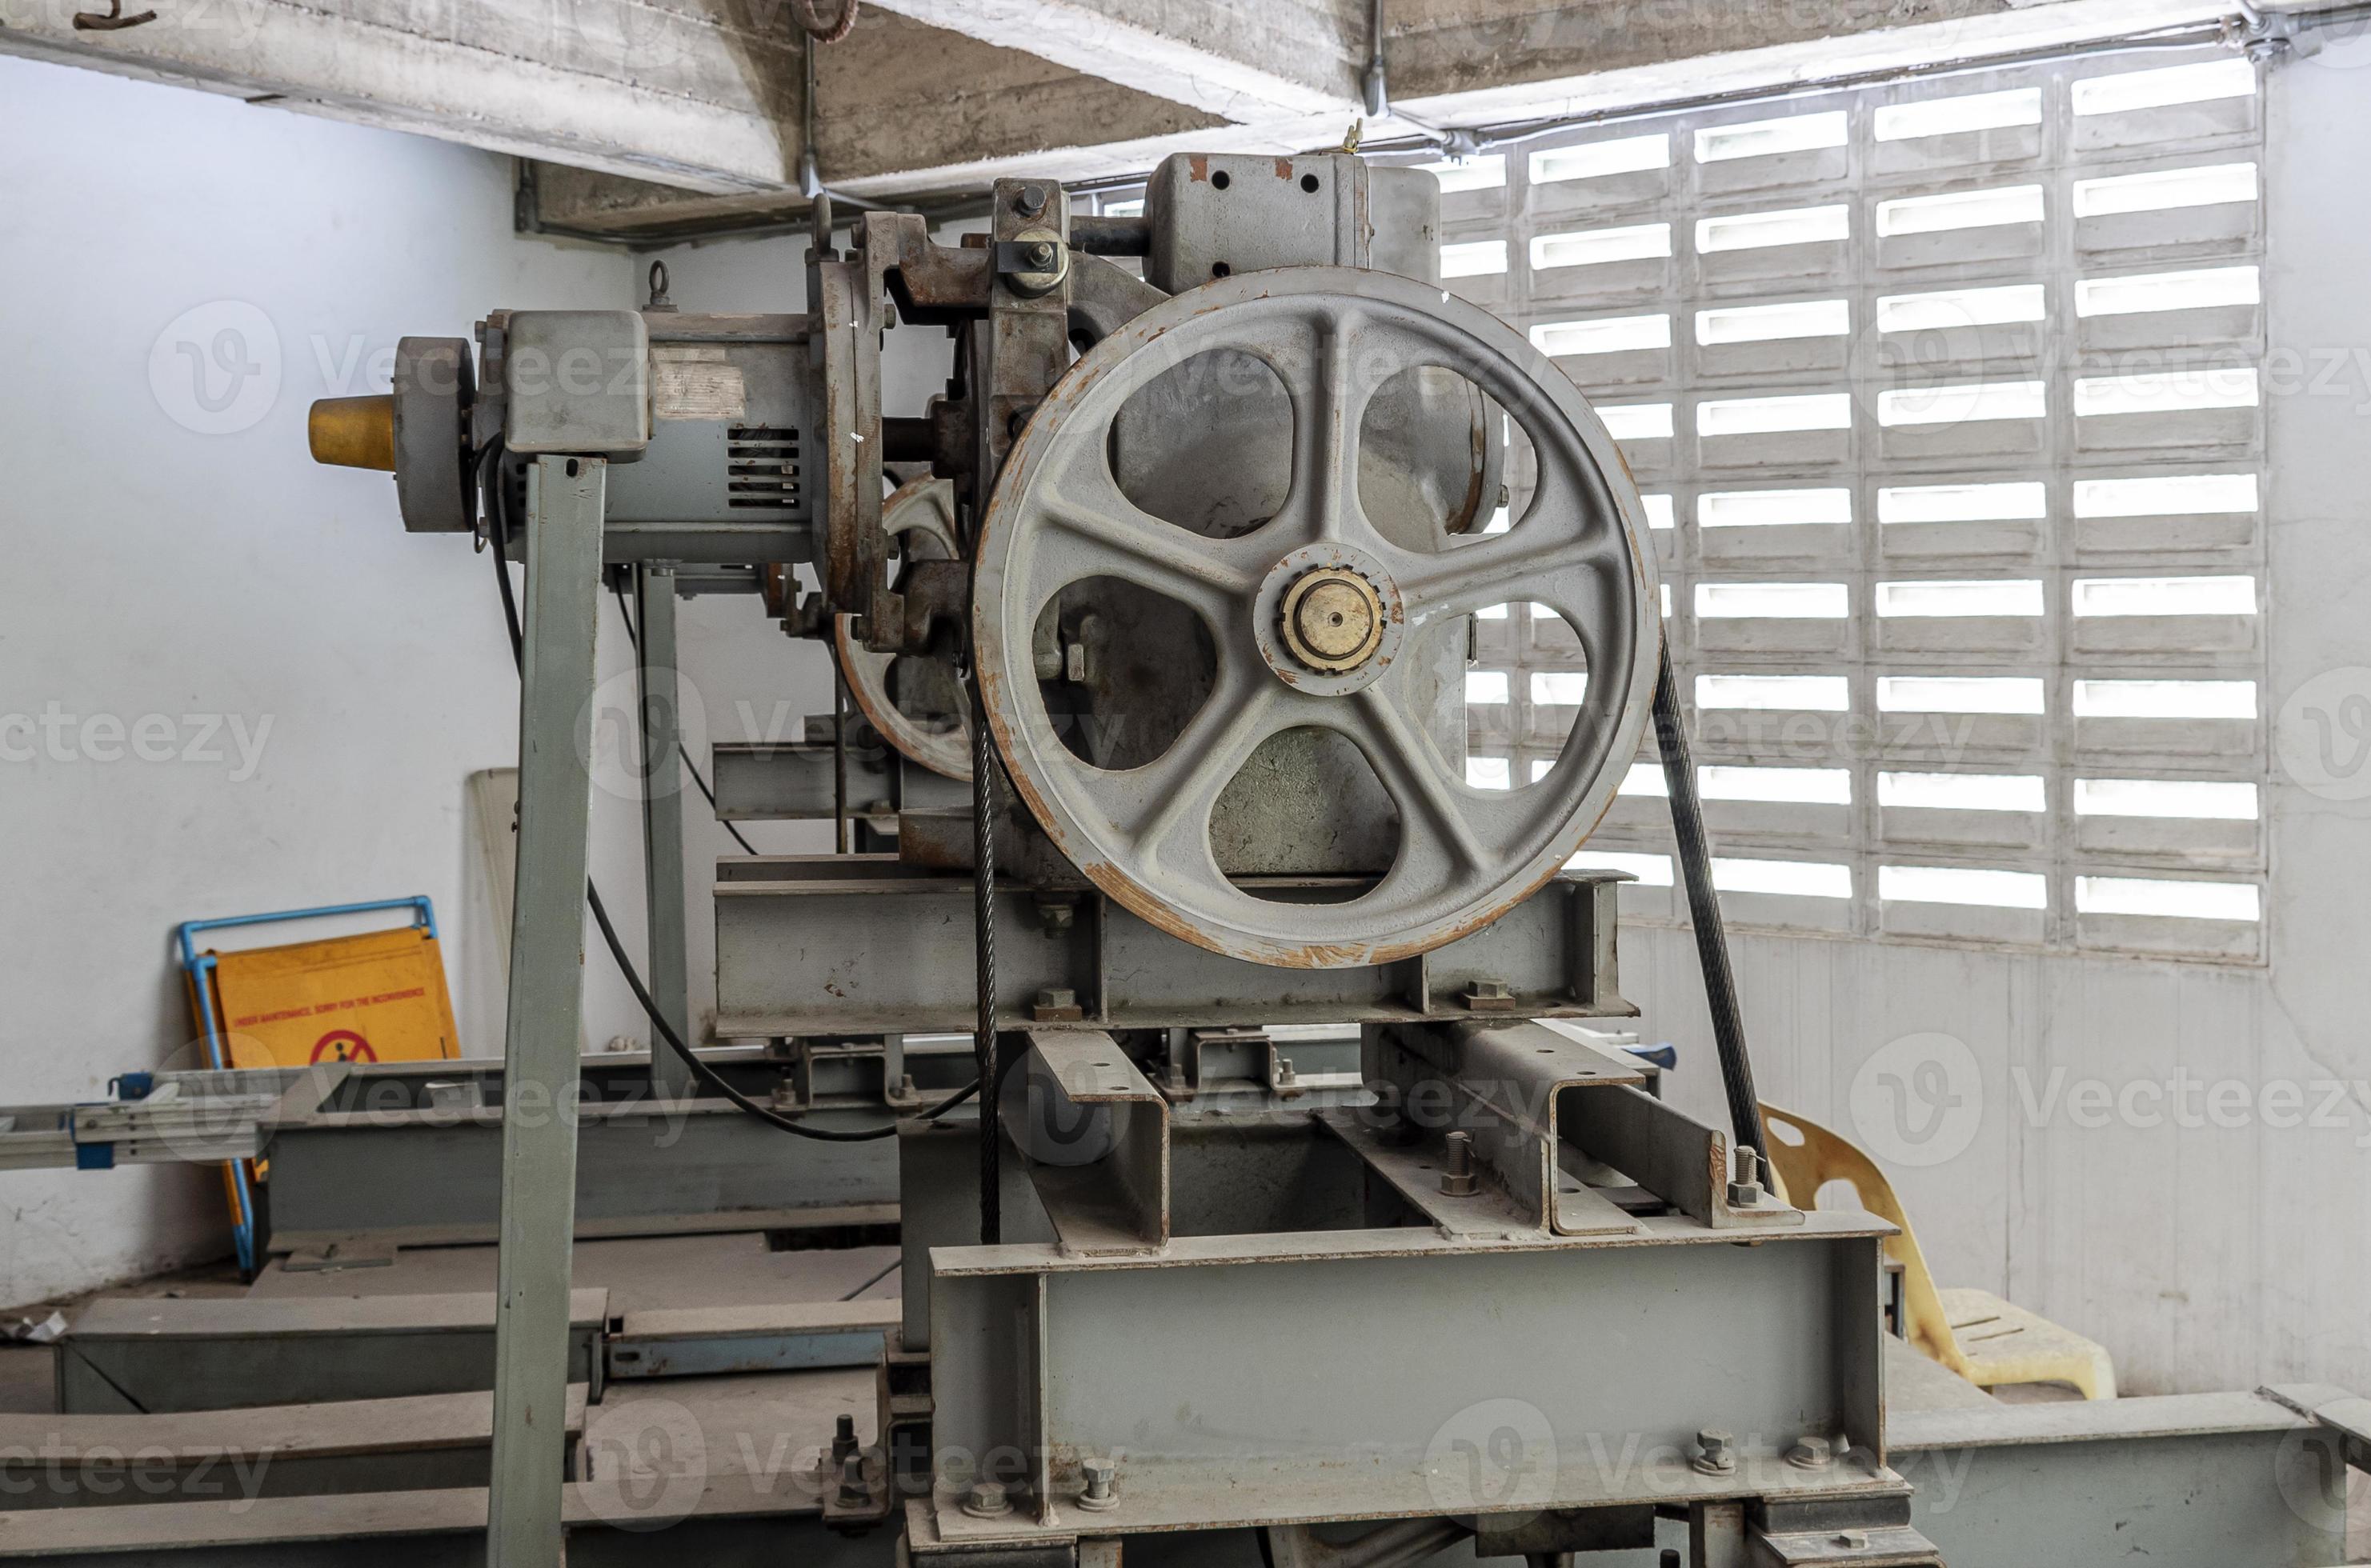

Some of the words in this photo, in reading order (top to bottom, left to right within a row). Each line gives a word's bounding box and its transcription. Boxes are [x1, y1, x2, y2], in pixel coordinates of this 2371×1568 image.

[315, 1002, 337, 1014] SORRY
[339, 999, 354, 1010] FOR
[357, 997, 369, 1006] THE
[371, 986, 424, 1005] INCONVENIENCE
